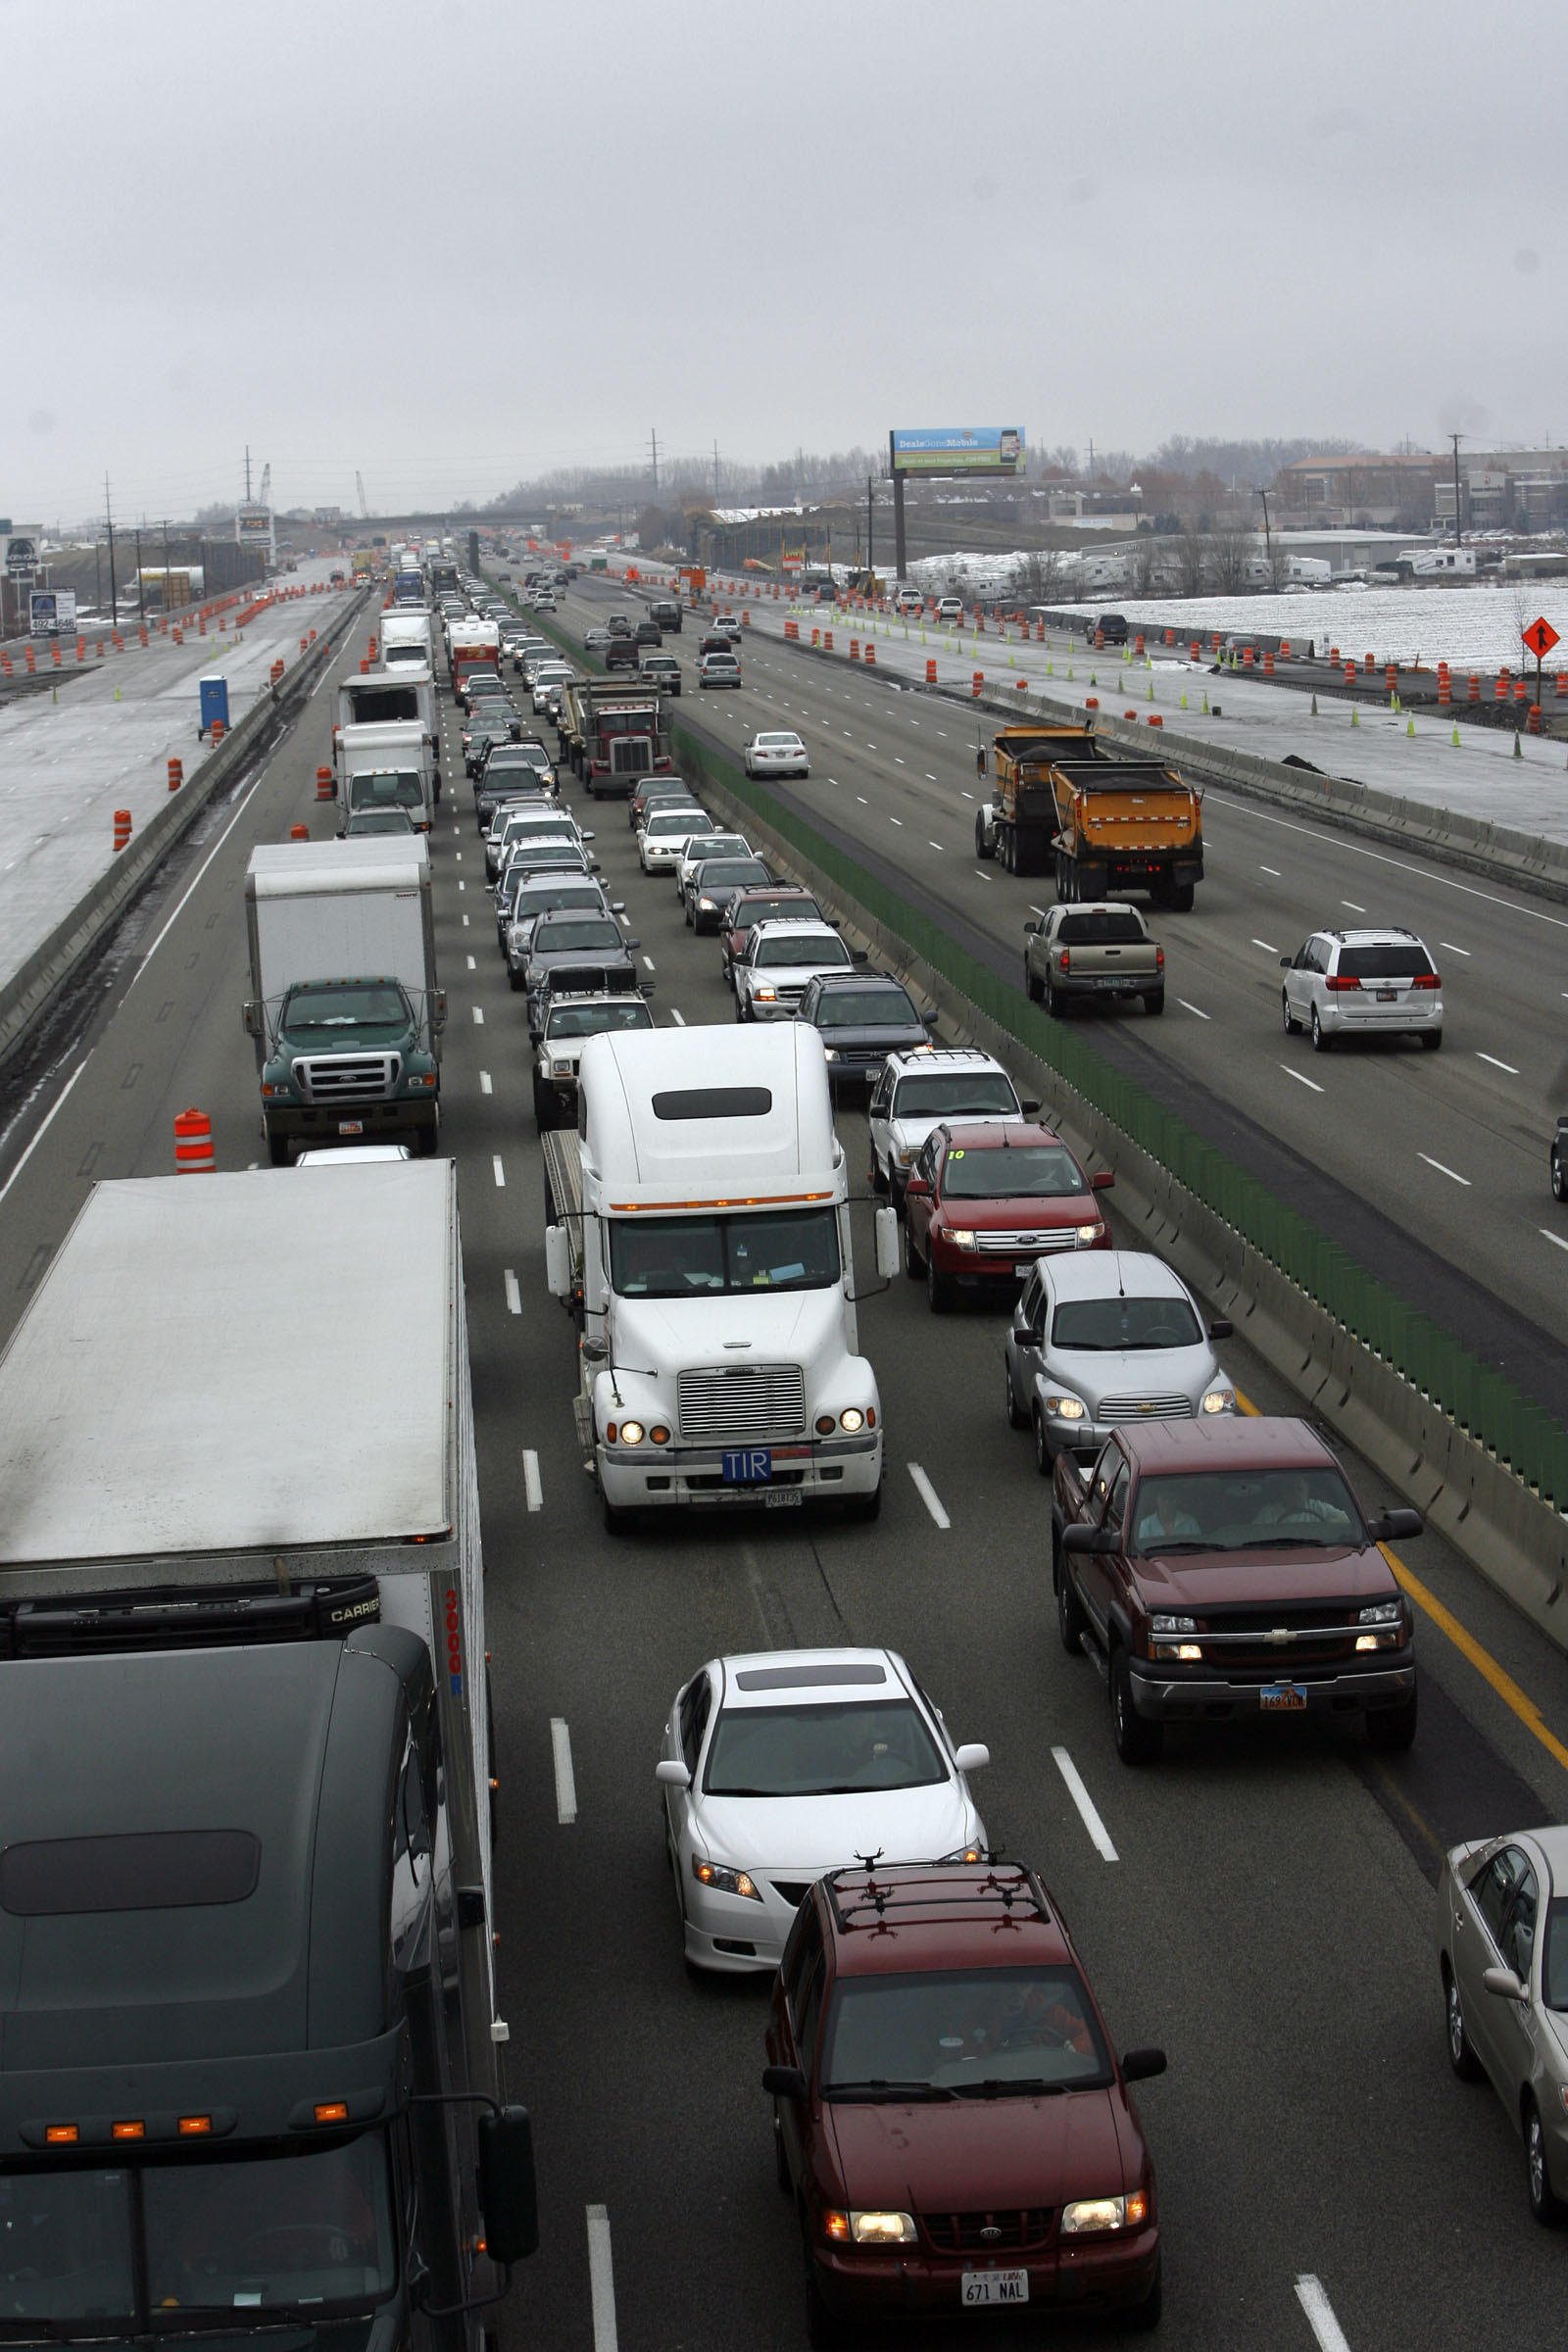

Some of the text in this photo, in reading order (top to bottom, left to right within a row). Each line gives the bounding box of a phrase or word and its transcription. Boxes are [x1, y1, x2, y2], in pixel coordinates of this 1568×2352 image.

[949, 1151, 965, 1159] 10
[726, 1452, 767, 1478] TIR
[331, 1597, 379, 1622] CARRIER
[966, 2281, 1024, 2301] 671 NAL
